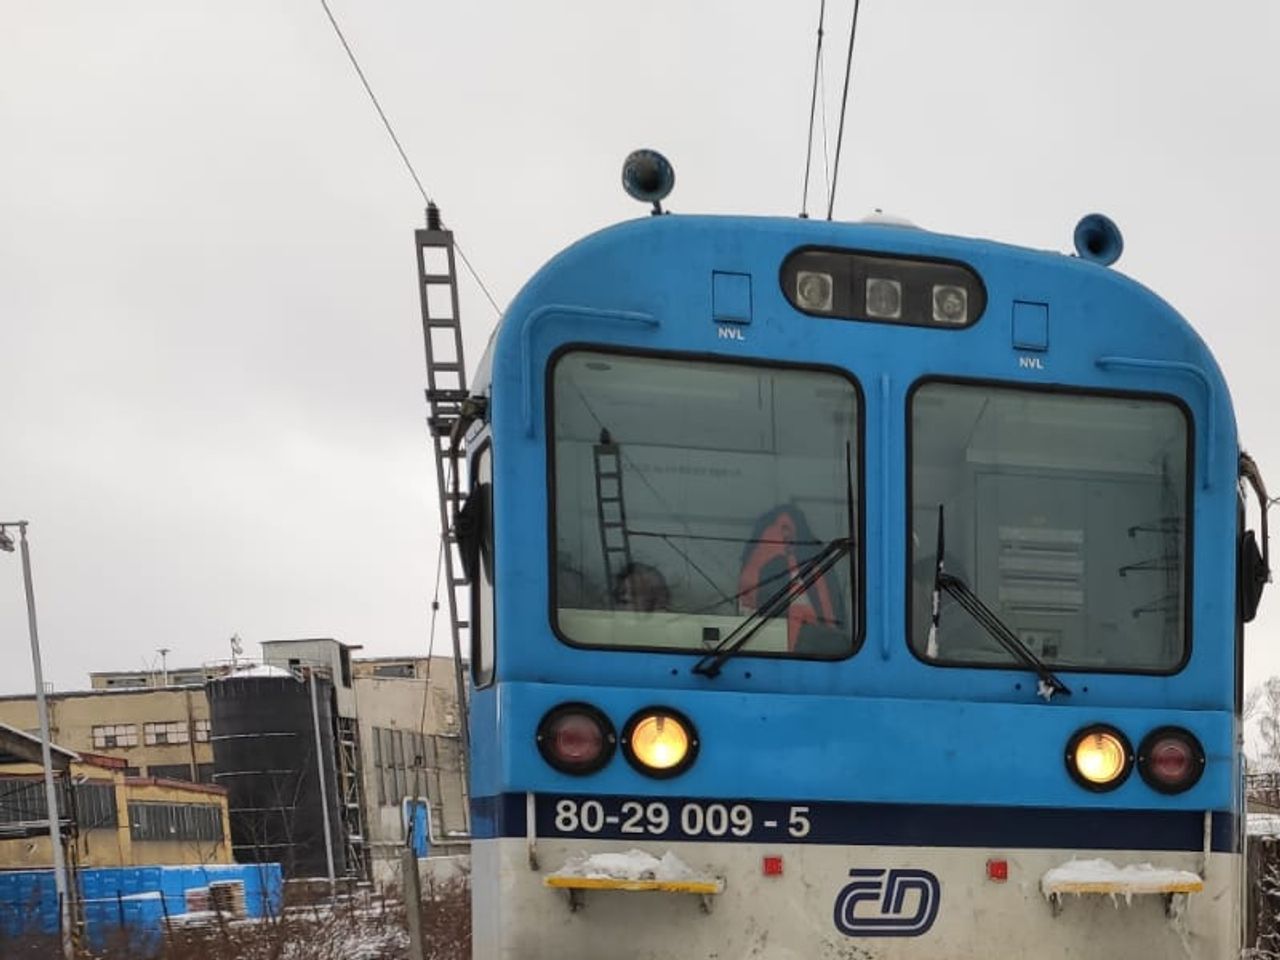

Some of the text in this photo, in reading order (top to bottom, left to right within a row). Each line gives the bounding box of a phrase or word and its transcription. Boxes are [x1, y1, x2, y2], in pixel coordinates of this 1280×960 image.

[718, 327, 745, 341] NVL
[1019, 356, 1044, 370] NVL
[555, 800, 670, 834] 80-29
